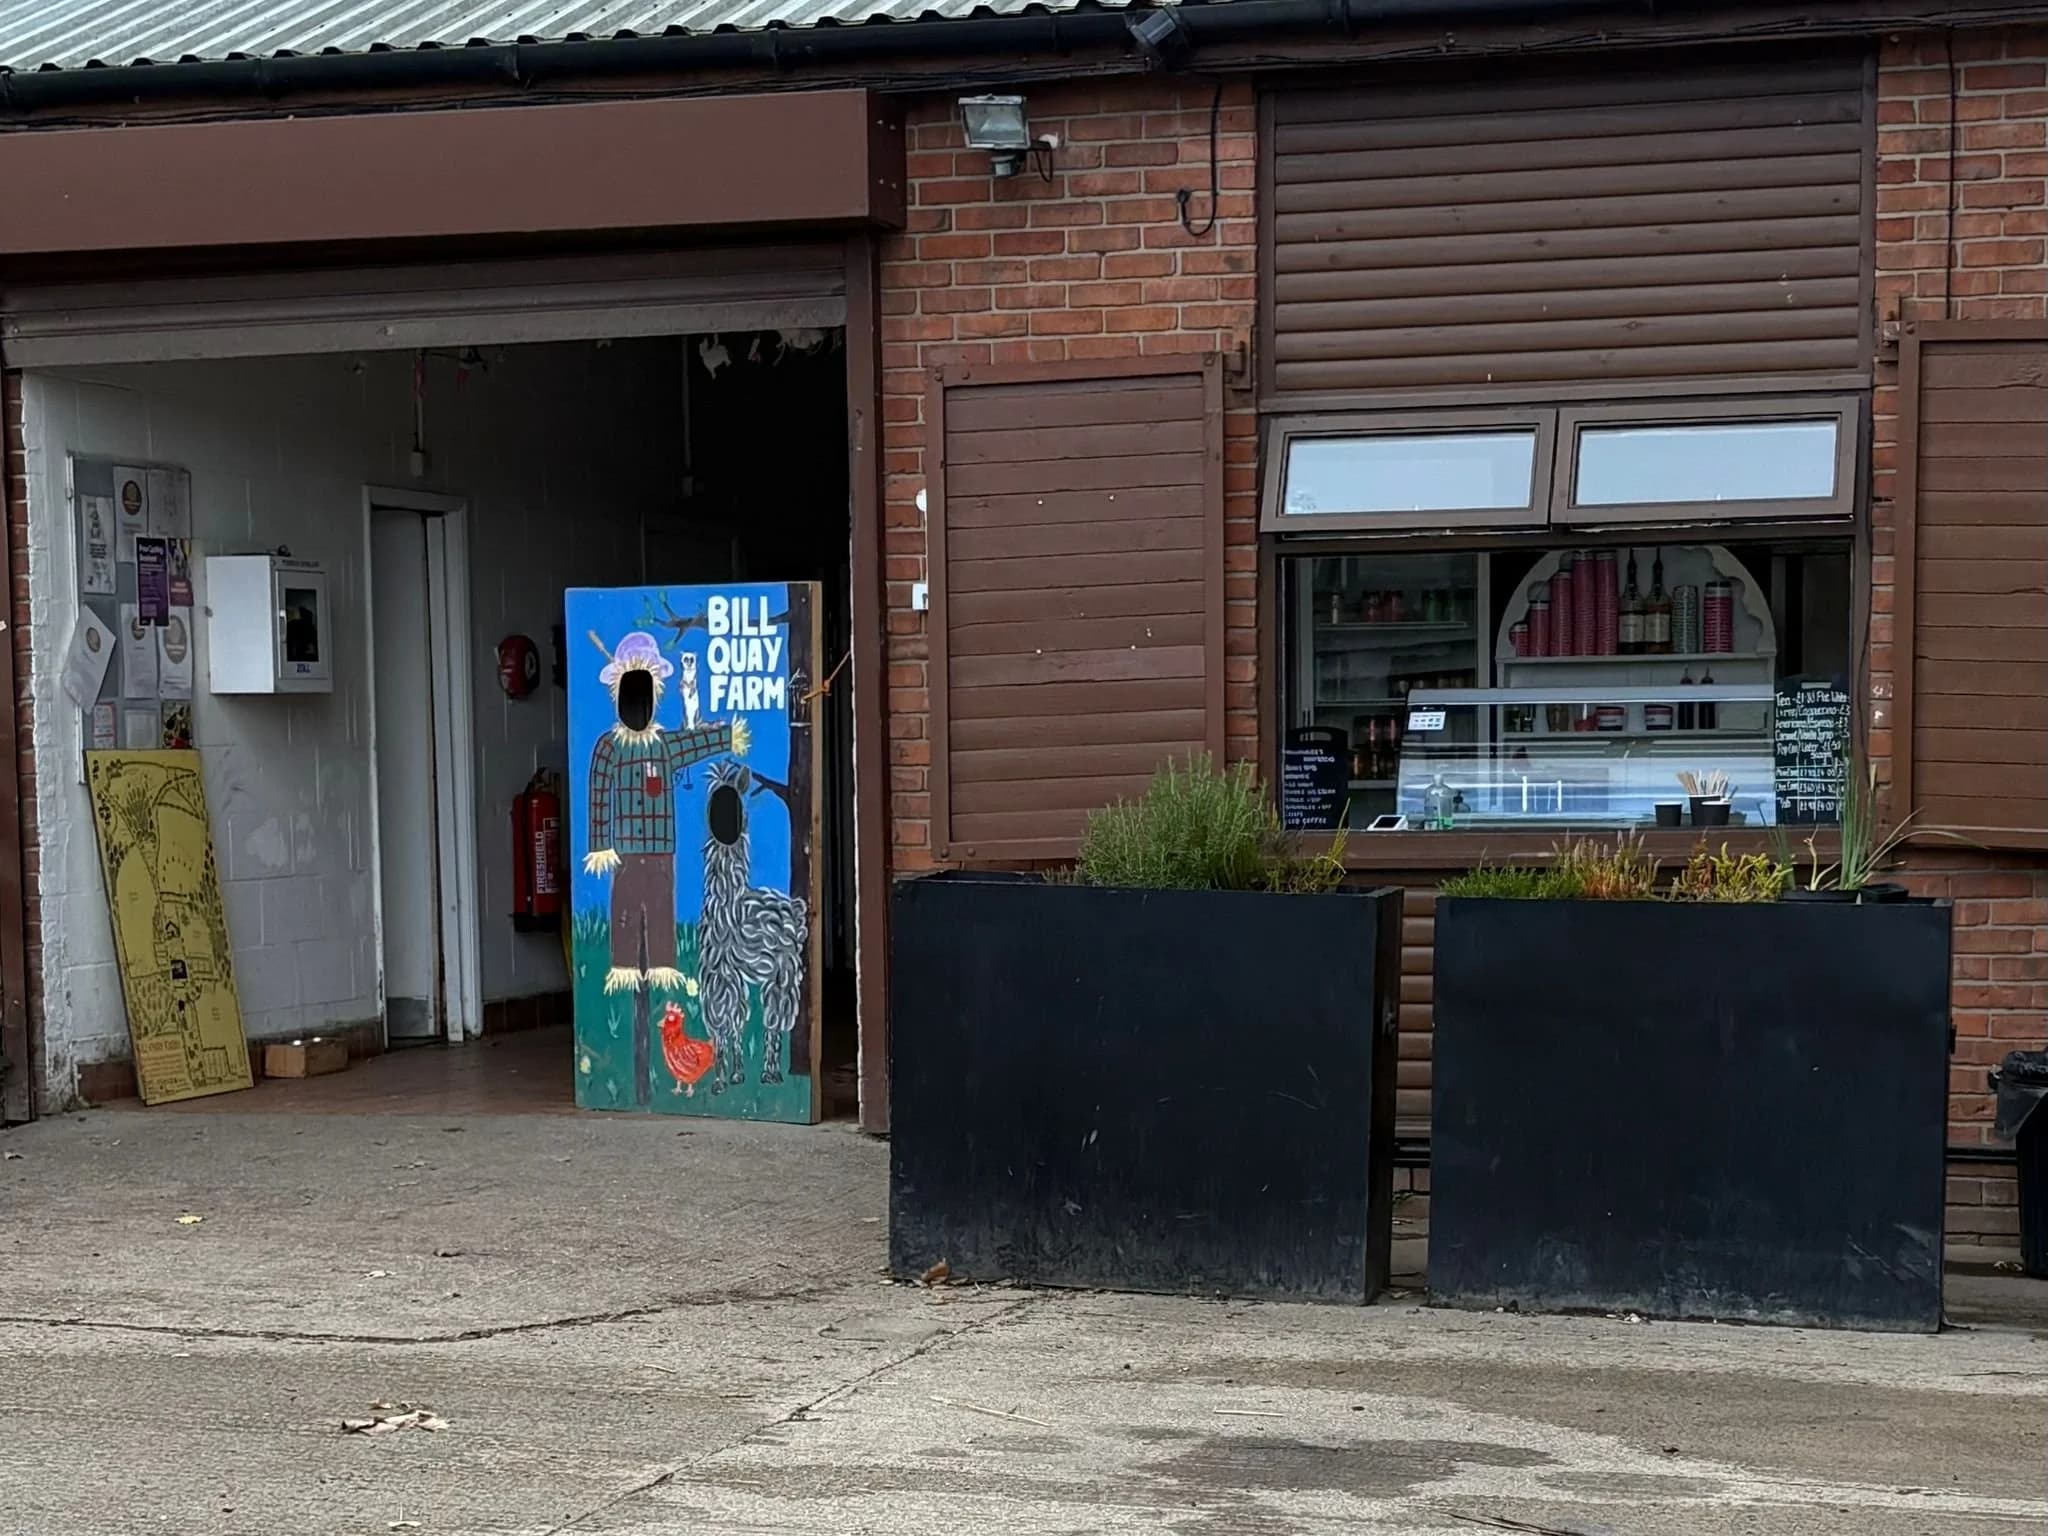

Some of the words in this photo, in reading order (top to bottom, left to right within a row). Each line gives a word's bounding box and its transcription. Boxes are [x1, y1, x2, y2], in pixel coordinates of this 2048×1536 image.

[708, 596, 778, 636] BILL
[707, 636, 783, 674] QUAY
[710, 675, 784, 712] FARM
[536, 831, 545, 894] FIRESHIELD
